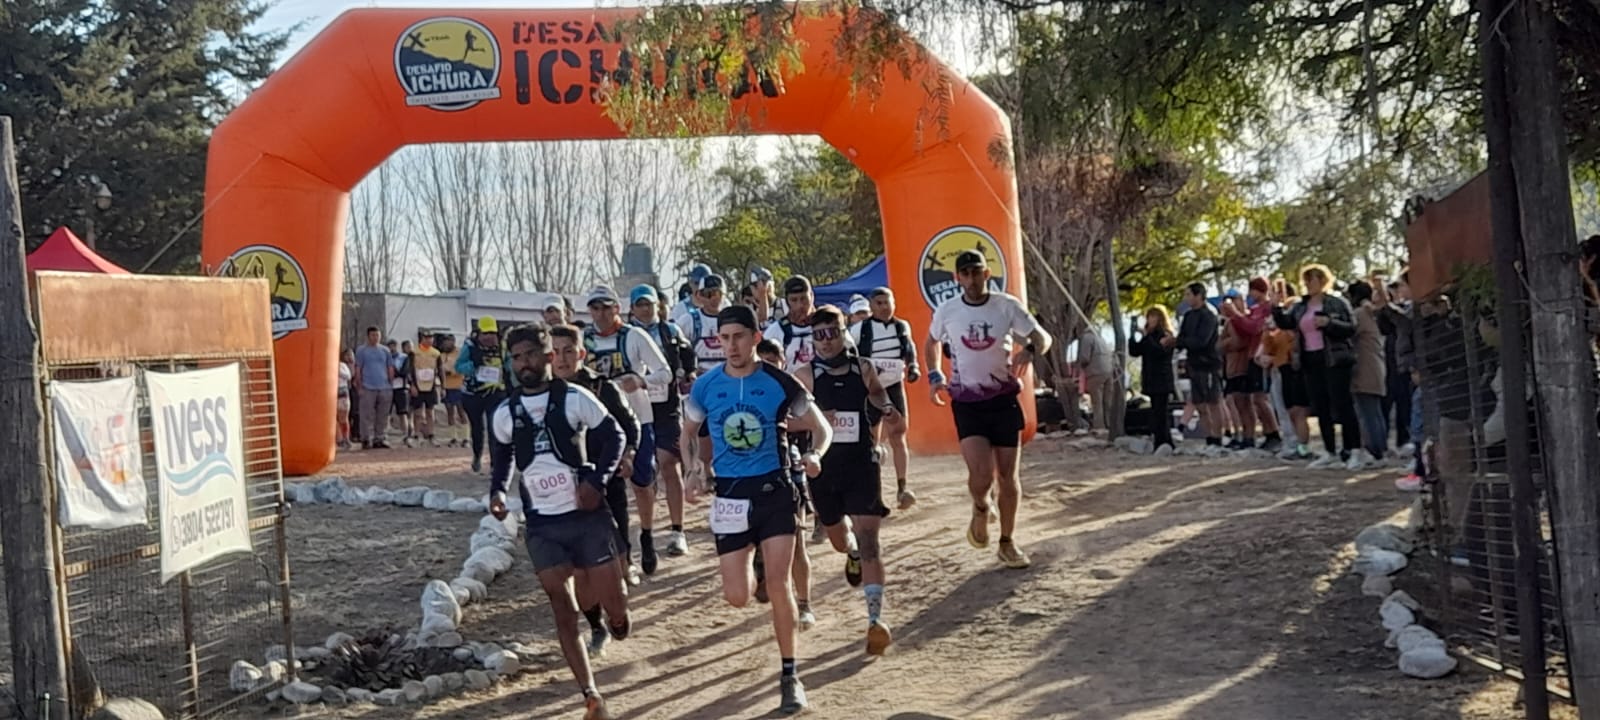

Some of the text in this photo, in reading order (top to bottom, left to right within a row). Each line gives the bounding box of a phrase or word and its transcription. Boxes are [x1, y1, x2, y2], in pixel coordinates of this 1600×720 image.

[512, 21, 624, 44] DESA
[405, 62, 453, 76] DESAFIO
[410, 70, 488, 93] ICHURA
[539, 472, 568, 490] 008
[719, 502, 744, 515] 026
[180, 509, 204, 547] 3804
